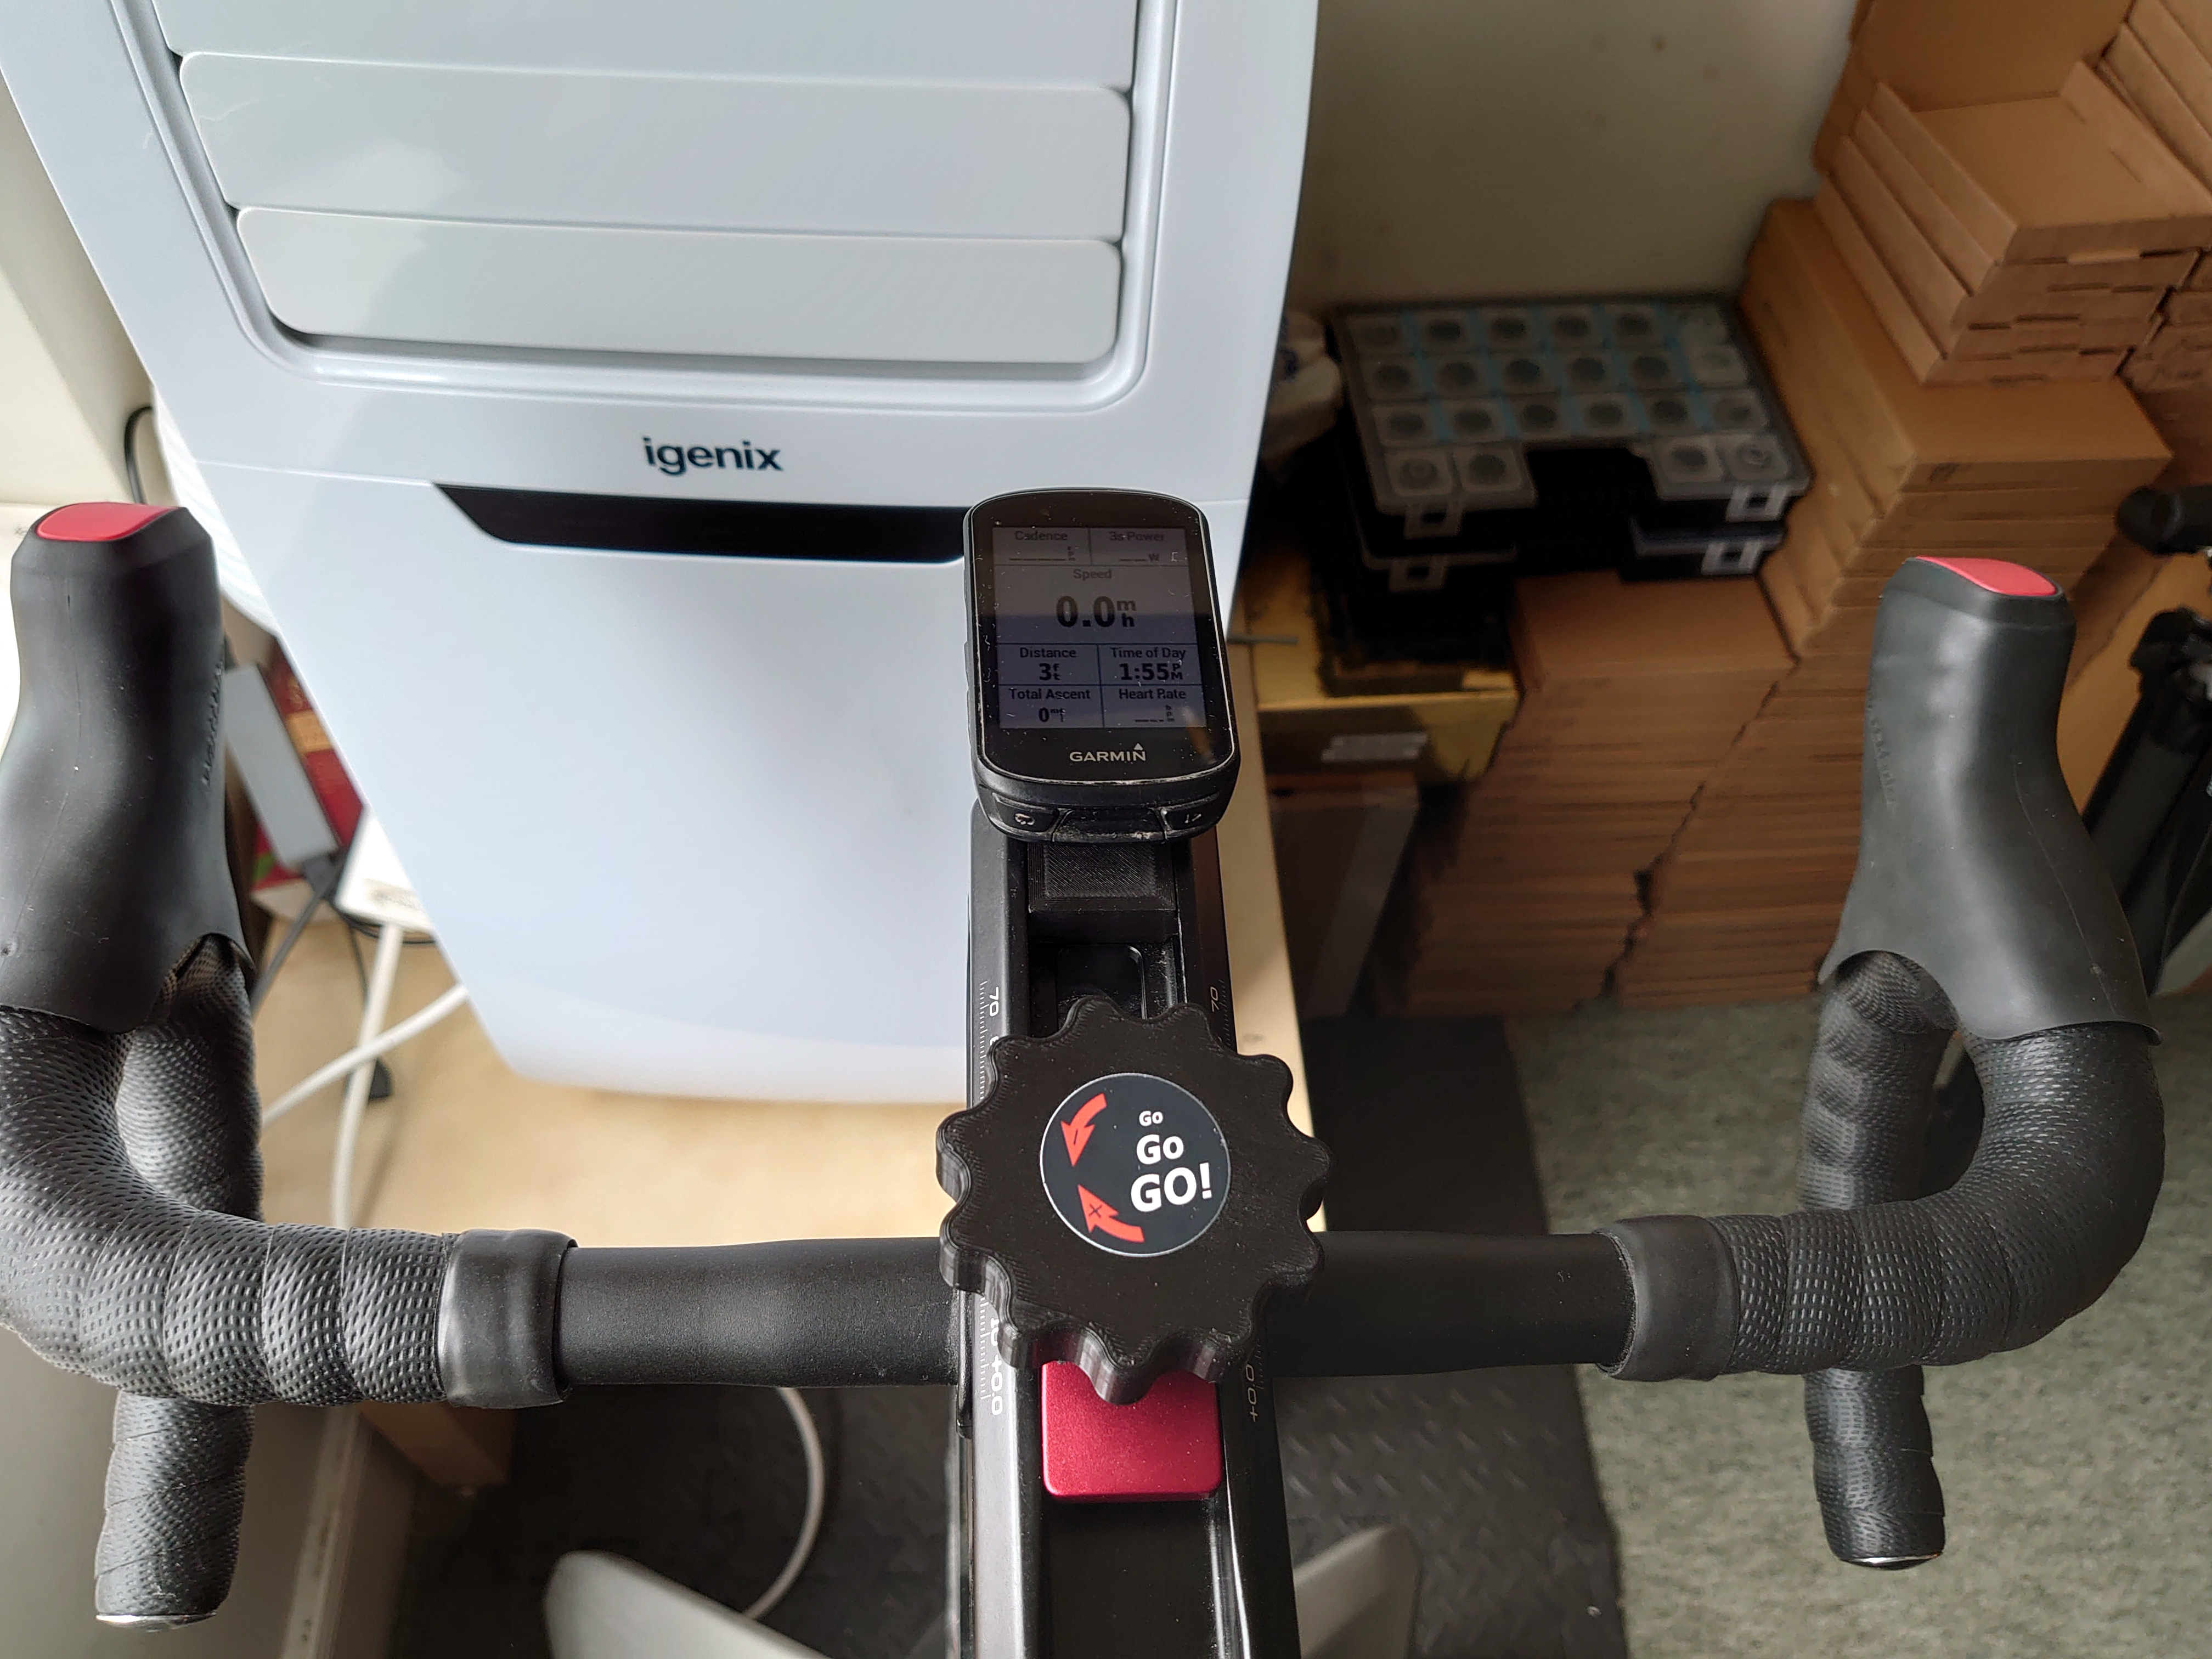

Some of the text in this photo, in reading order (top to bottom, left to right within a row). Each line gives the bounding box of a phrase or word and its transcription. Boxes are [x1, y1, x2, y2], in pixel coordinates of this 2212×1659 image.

[642, 437, 783, 476] igenix
[1015, 531, 1068, 541] Cadence
[1109, 531, 1165, 541] 3s Power
[1073, 568, 1113, 580] Speed
[1056, 595, 1116, 628] 0.0
[1019, 647, 1077, 658] Distance
[1109, 647, 1187, 660] Time of Day
[1119, 663, 1170, 681] 1:55
[1008, 687, 1091, 700] Total Ascent
[1118, 688, 1187, 699] Heart Rate
[1069, 750, 1147, 762] GARMIN
[989, 986, 999, 1017] 70
[1210, 986, 1220, 1013] 70
[1131, 1162, 1212, 1212] GO!
